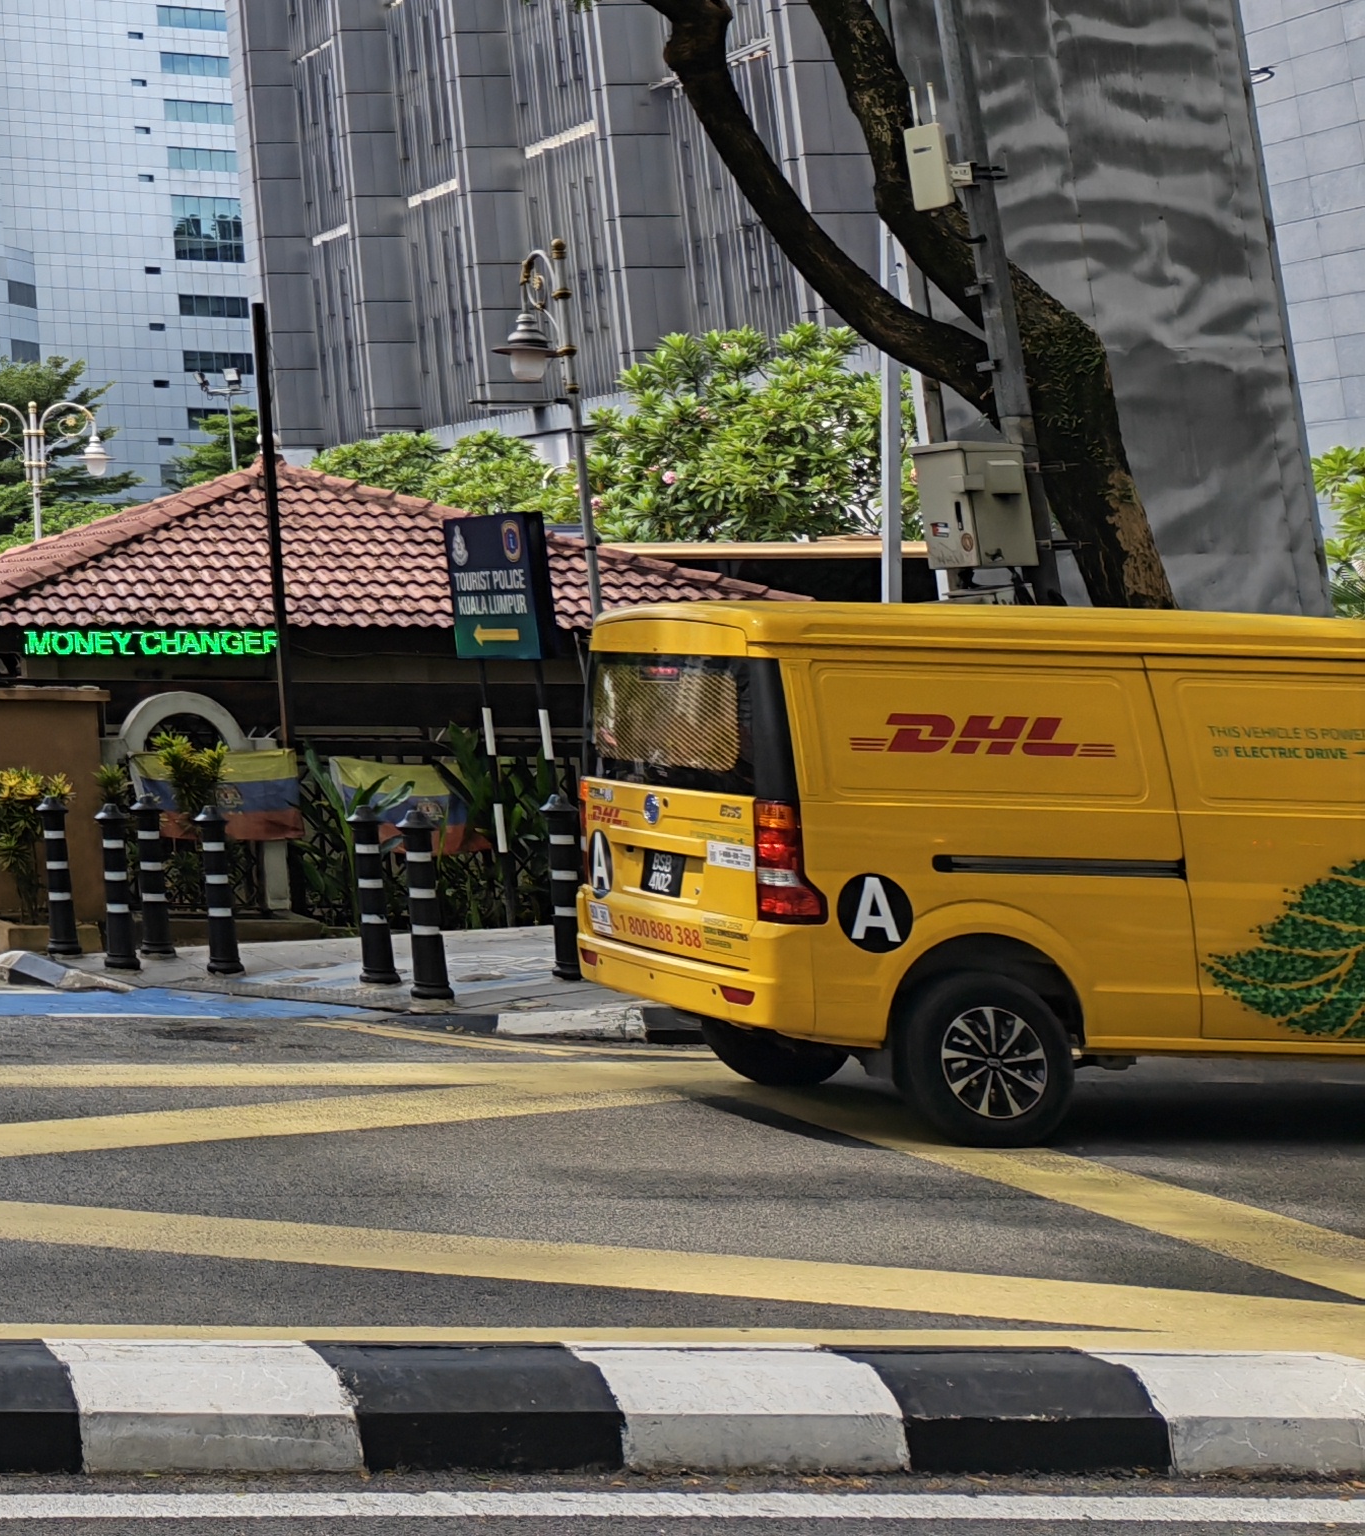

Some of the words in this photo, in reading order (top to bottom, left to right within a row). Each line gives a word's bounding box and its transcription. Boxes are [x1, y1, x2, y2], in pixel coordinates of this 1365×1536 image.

[454, 571, 491, 591] TOURIST
[492, 569, 526, 590] POLICE
[458, 595, 488, 615] KUALA
[489, 594, 527, 614] LUMPUR
[24, 631, 135, 655] MONEY
[885, 713, 1078, 757] DHL
[1207, 725, 1241, 737] THIS
[1242, 726, 1302, 739] VEHICLE
[1304, 727, 1319, 739] IS
[1213, 745, 1230, 758] BY
[1234, 746, 1303, 759] ELECTRIC
[1305, 747, 1348, 759] DRIVE
[591, 805, 625, 825] DHL
[593, 830, 611, 890] A
[652, 853, 673, 872] BSB
[648, 872, 672, 892] 4102
[850, 876, 902, 943] A
[620, 914, 627, 933] 1
[675, 925, 702, 949] 388
